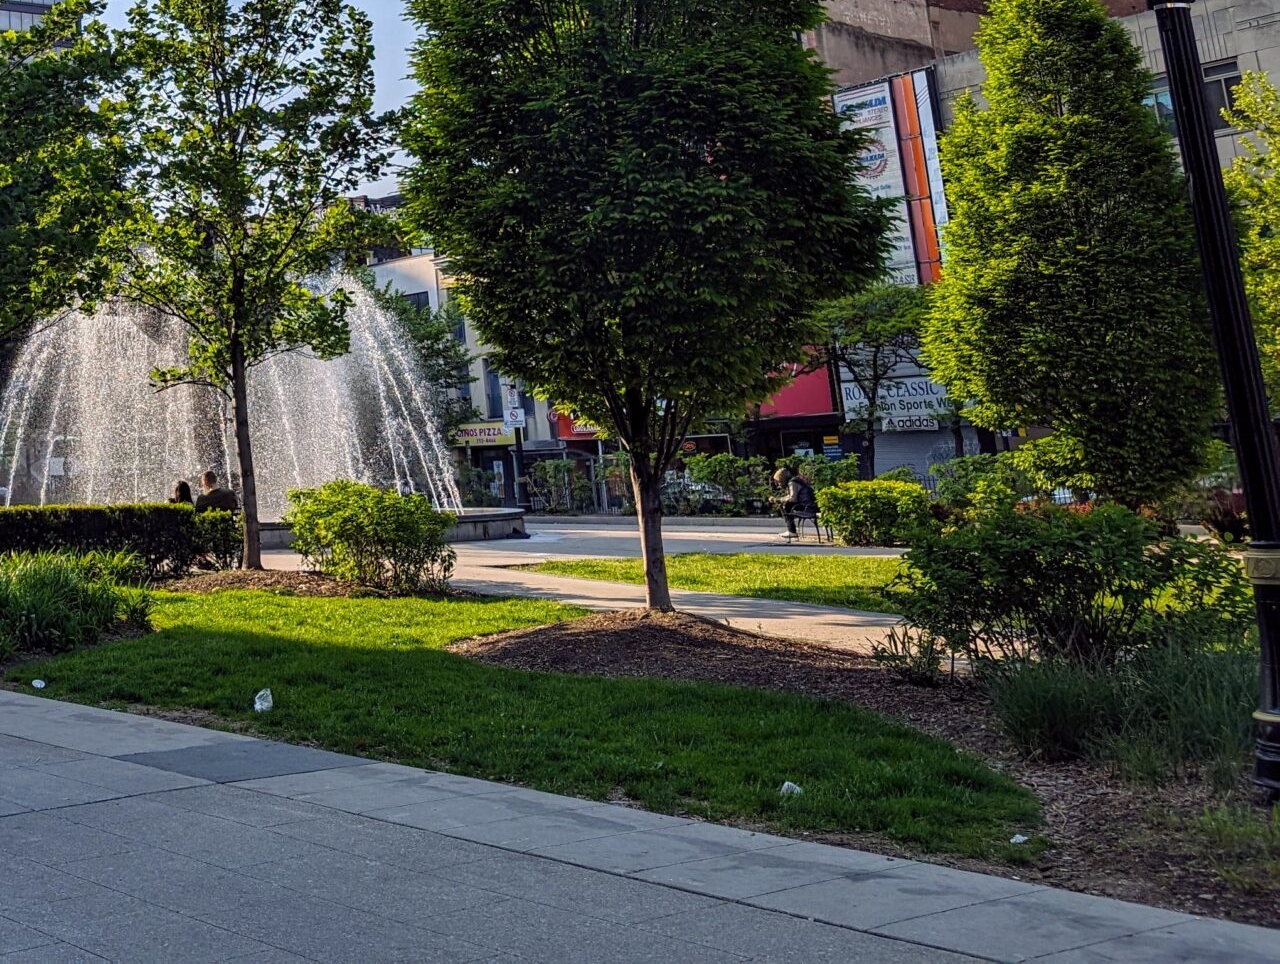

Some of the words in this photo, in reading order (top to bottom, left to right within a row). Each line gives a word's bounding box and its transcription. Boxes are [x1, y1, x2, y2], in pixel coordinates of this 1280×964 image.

[887, 380, 939, 398] CLASSIC
[898, 398, 935, 412] Sports
[897, 416, 935, 428] adidas
[479, 427, 503, 437] PIZZA
